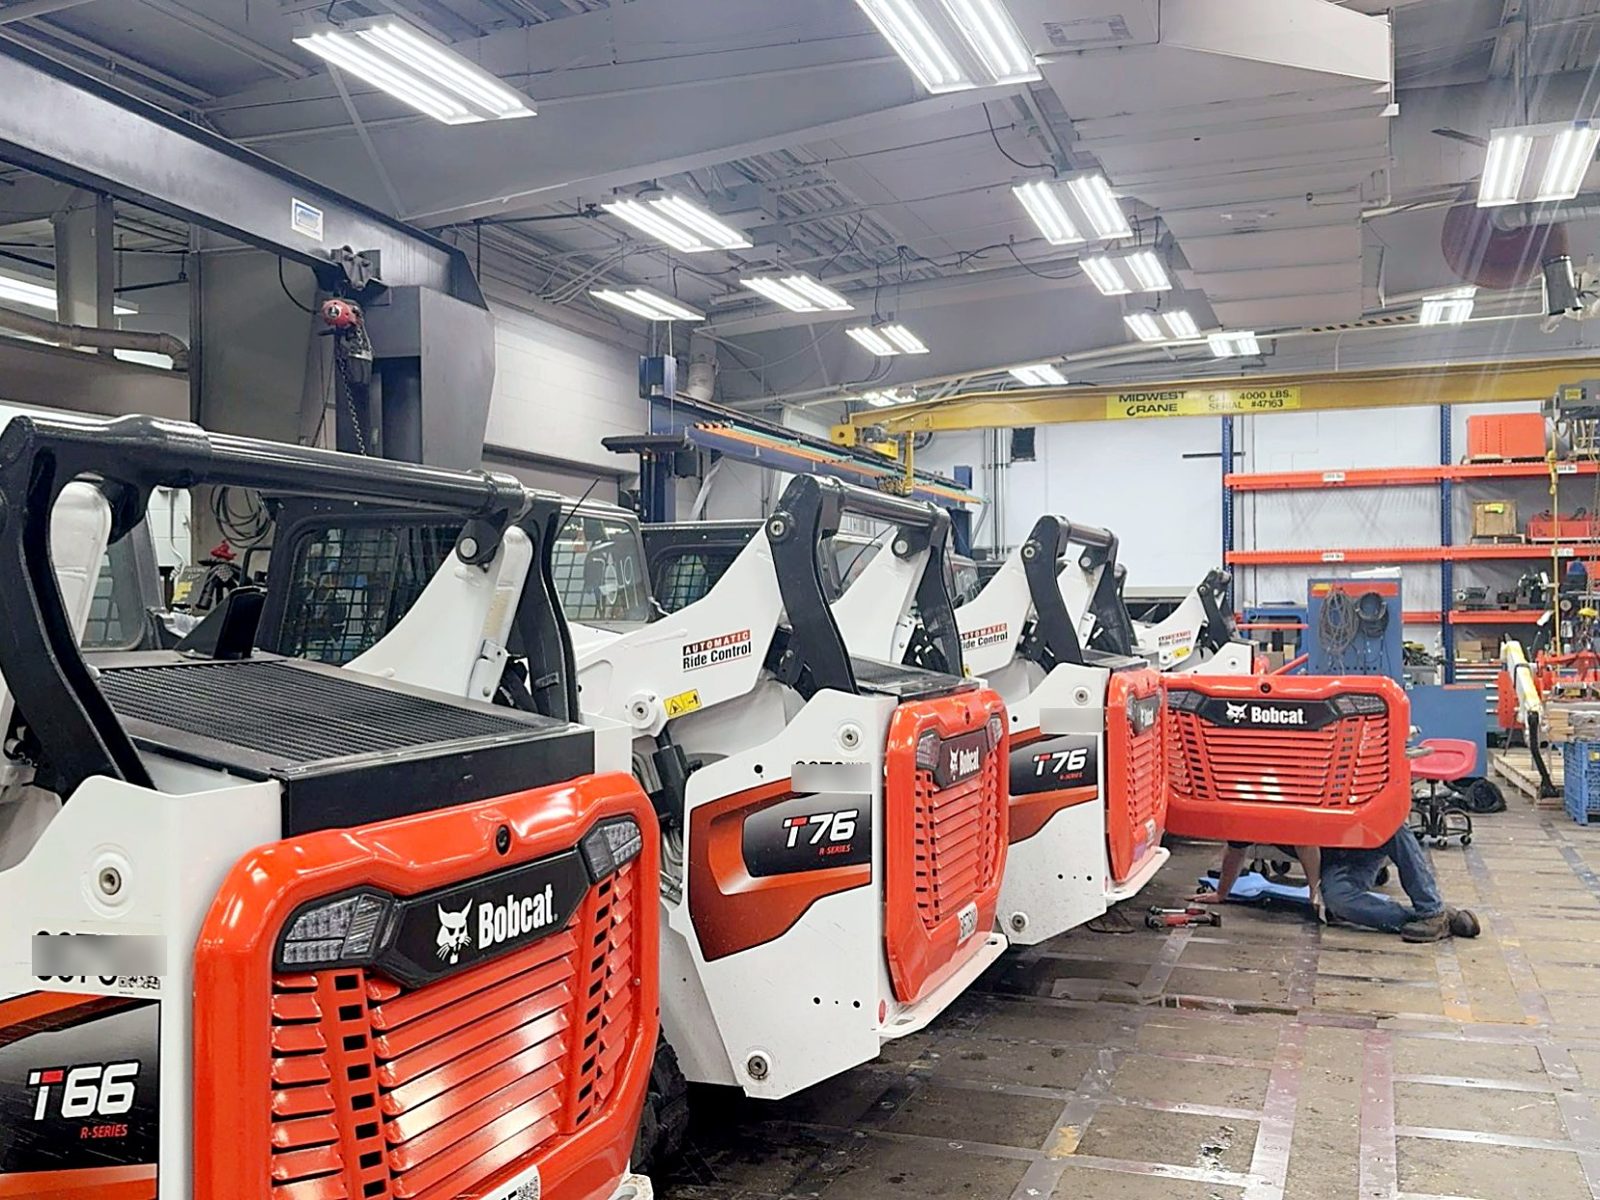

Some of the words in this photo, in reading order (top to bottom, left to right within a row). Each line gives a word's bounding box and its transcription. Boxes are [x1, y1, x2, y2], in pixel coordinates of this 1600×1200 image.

[1119, 391, 1187, 403] MIDWEST
[1239, 391, 1266, 400] 4000
[1269, 389, 1292, 399] LBS.
[1126, 403, 1178, 416] CRANE
[684, 631, 749, 655] AUTOMATIC
[978, 631, 1008, 646] Control
[683, 653, 707, 669] Ride
[710, 640, 752, 662] Control
[1251, 705, 1305, 724] Bobcat
[1033, 748, 1088, 776] T76
[783, 809, 858, 848] T76
[478, 883, 554, 950] Bobcat
[28, 1062, 139, 1121] T66
[80, 1124, 128, 1139] R-SERIES
